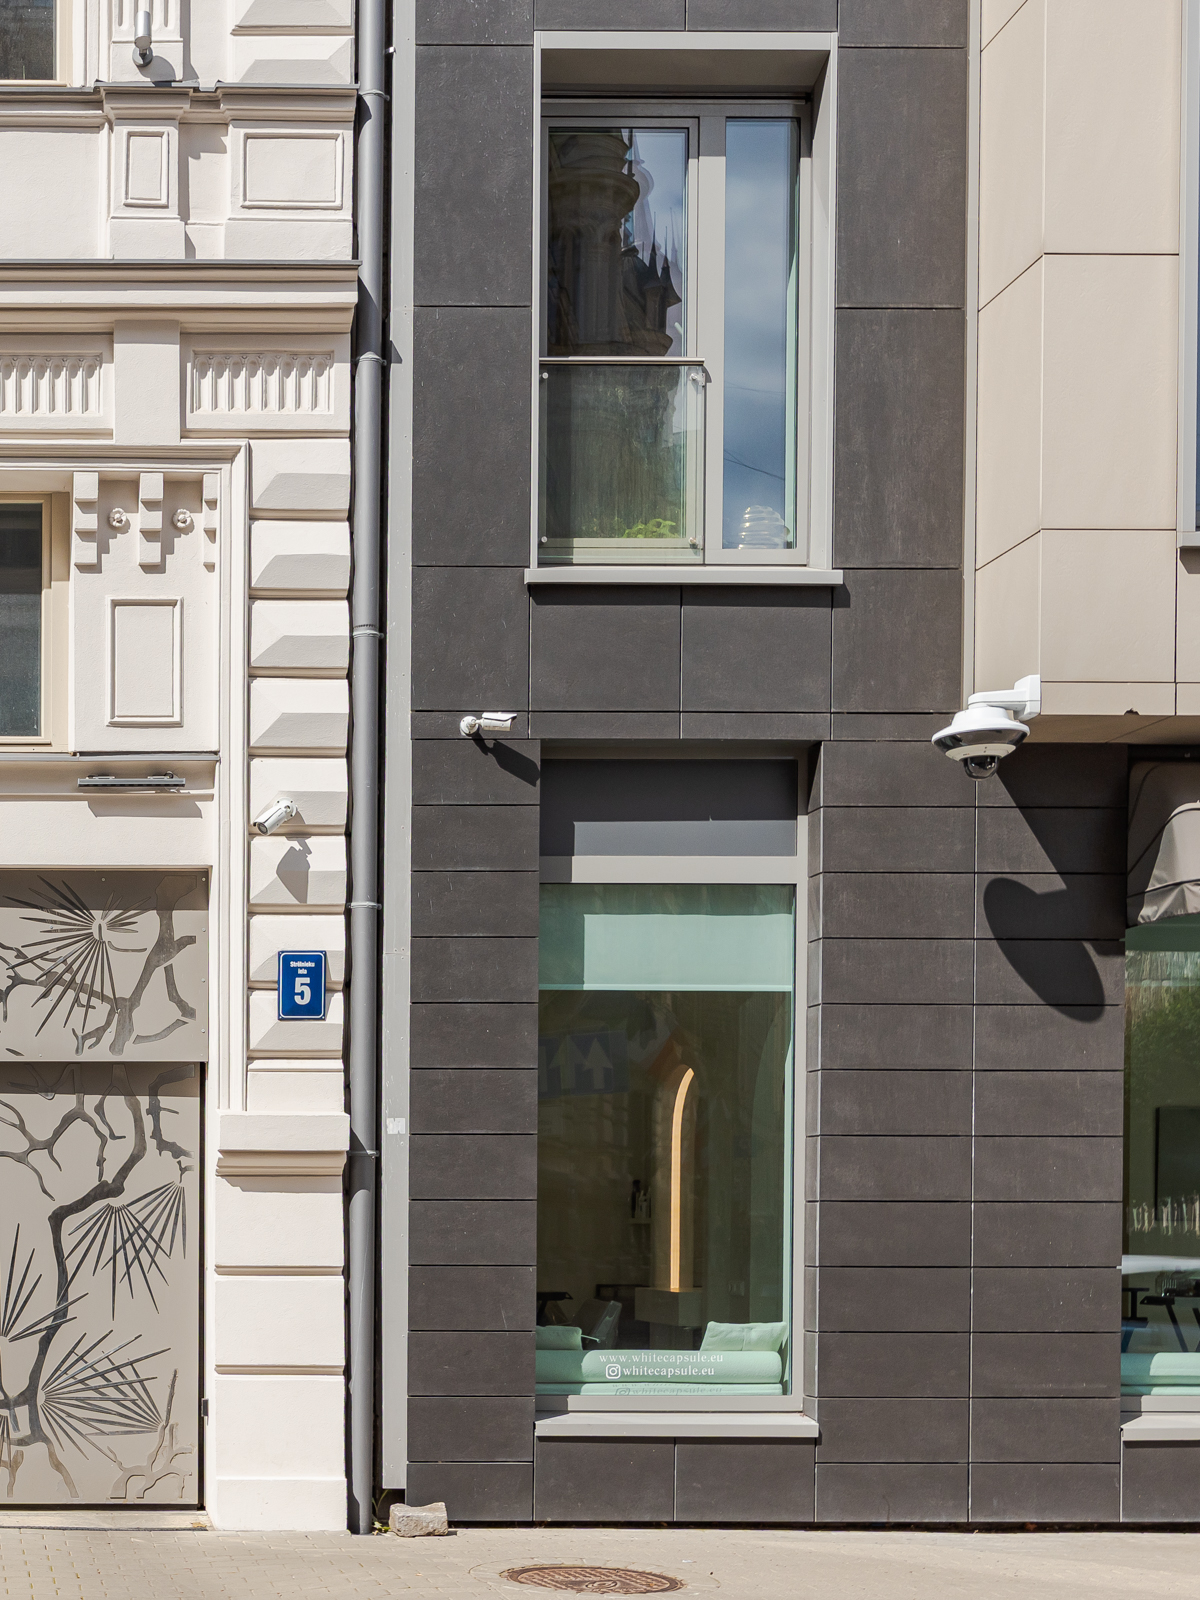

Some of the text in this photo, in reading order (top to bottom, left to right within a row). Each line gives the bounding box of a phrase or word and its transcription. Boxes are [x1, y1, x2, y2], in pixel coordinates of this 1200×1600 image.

[294, 977, 311, 1005] 5
[599, 1352, 723, 1365] www.whitecapsule.eu
[623, 1365, 715, 1378] whitecapsule.eu
